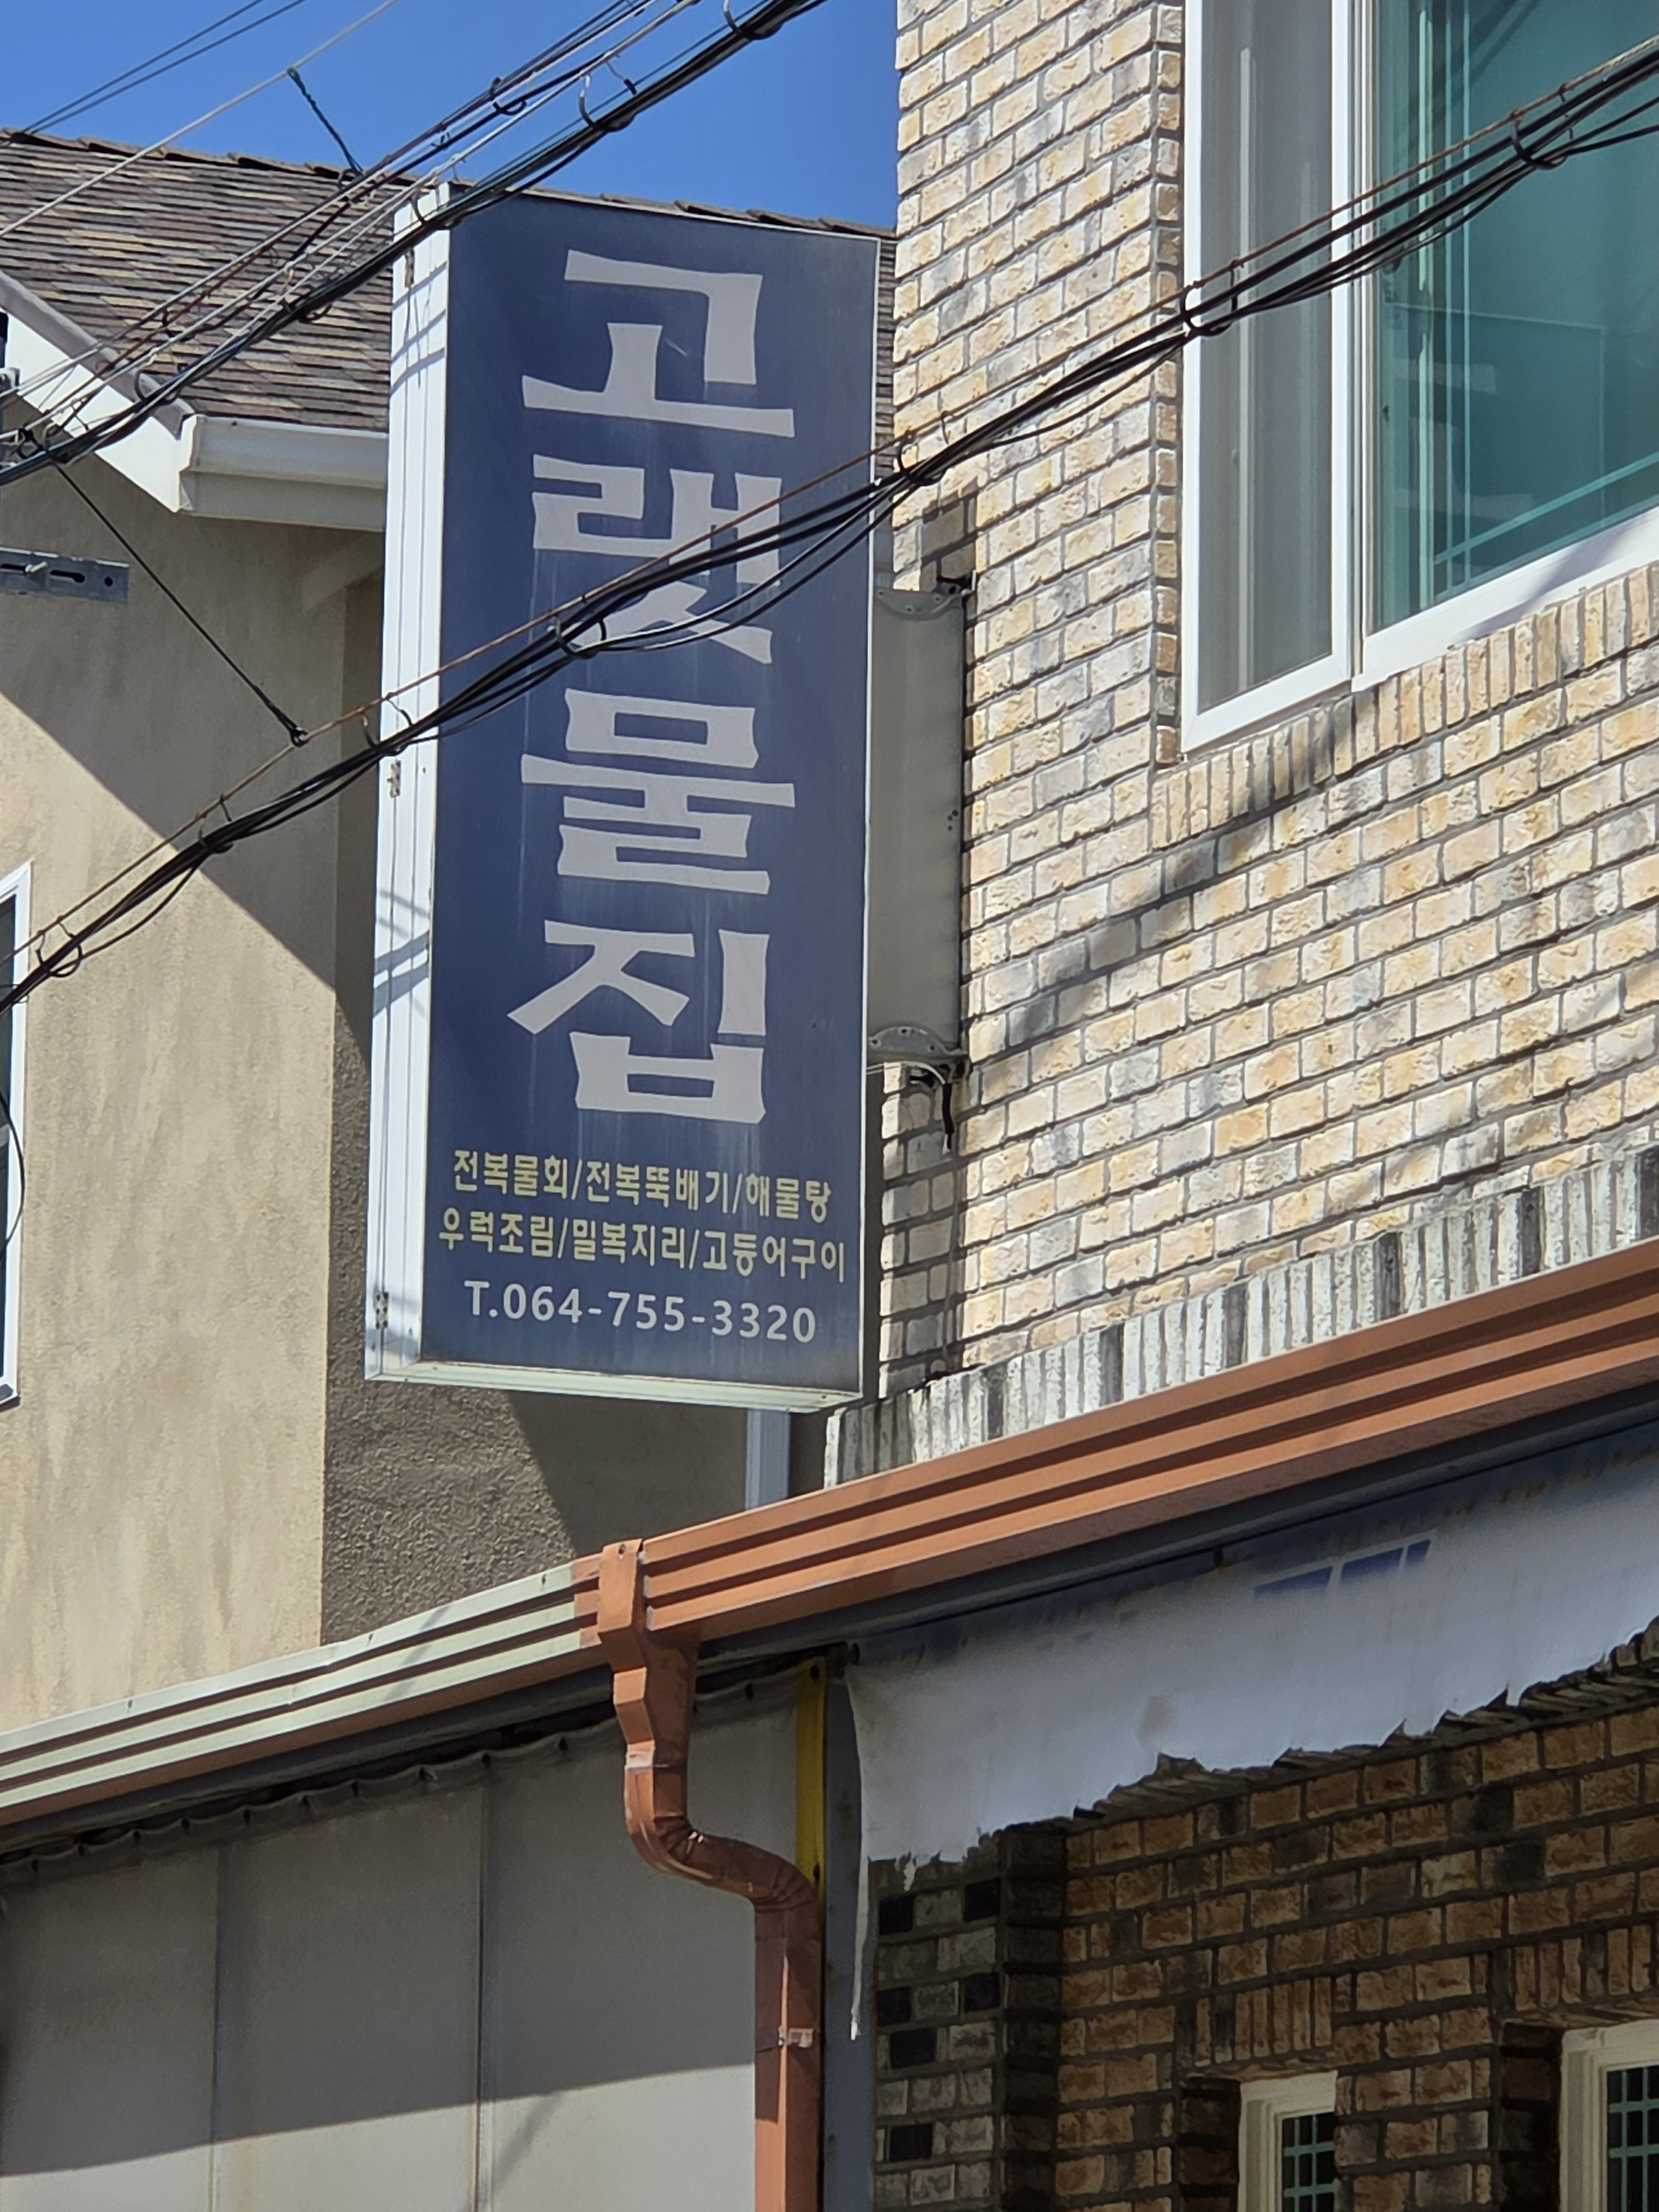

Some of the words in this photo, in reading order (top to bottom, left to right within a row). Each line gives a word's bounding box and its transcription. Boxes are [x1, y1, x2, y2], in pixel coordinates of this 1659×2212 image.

[506, 248, 796, 1125] 고랫물집
[453, 1149, 832, 1223] 전복물회/전복뚝배기/해물탕
[439, 1207, 845, 1283] 우럭조림/밀복지리/고등어구이
[463, 1279, 816, 1343] T.064-755-3320
